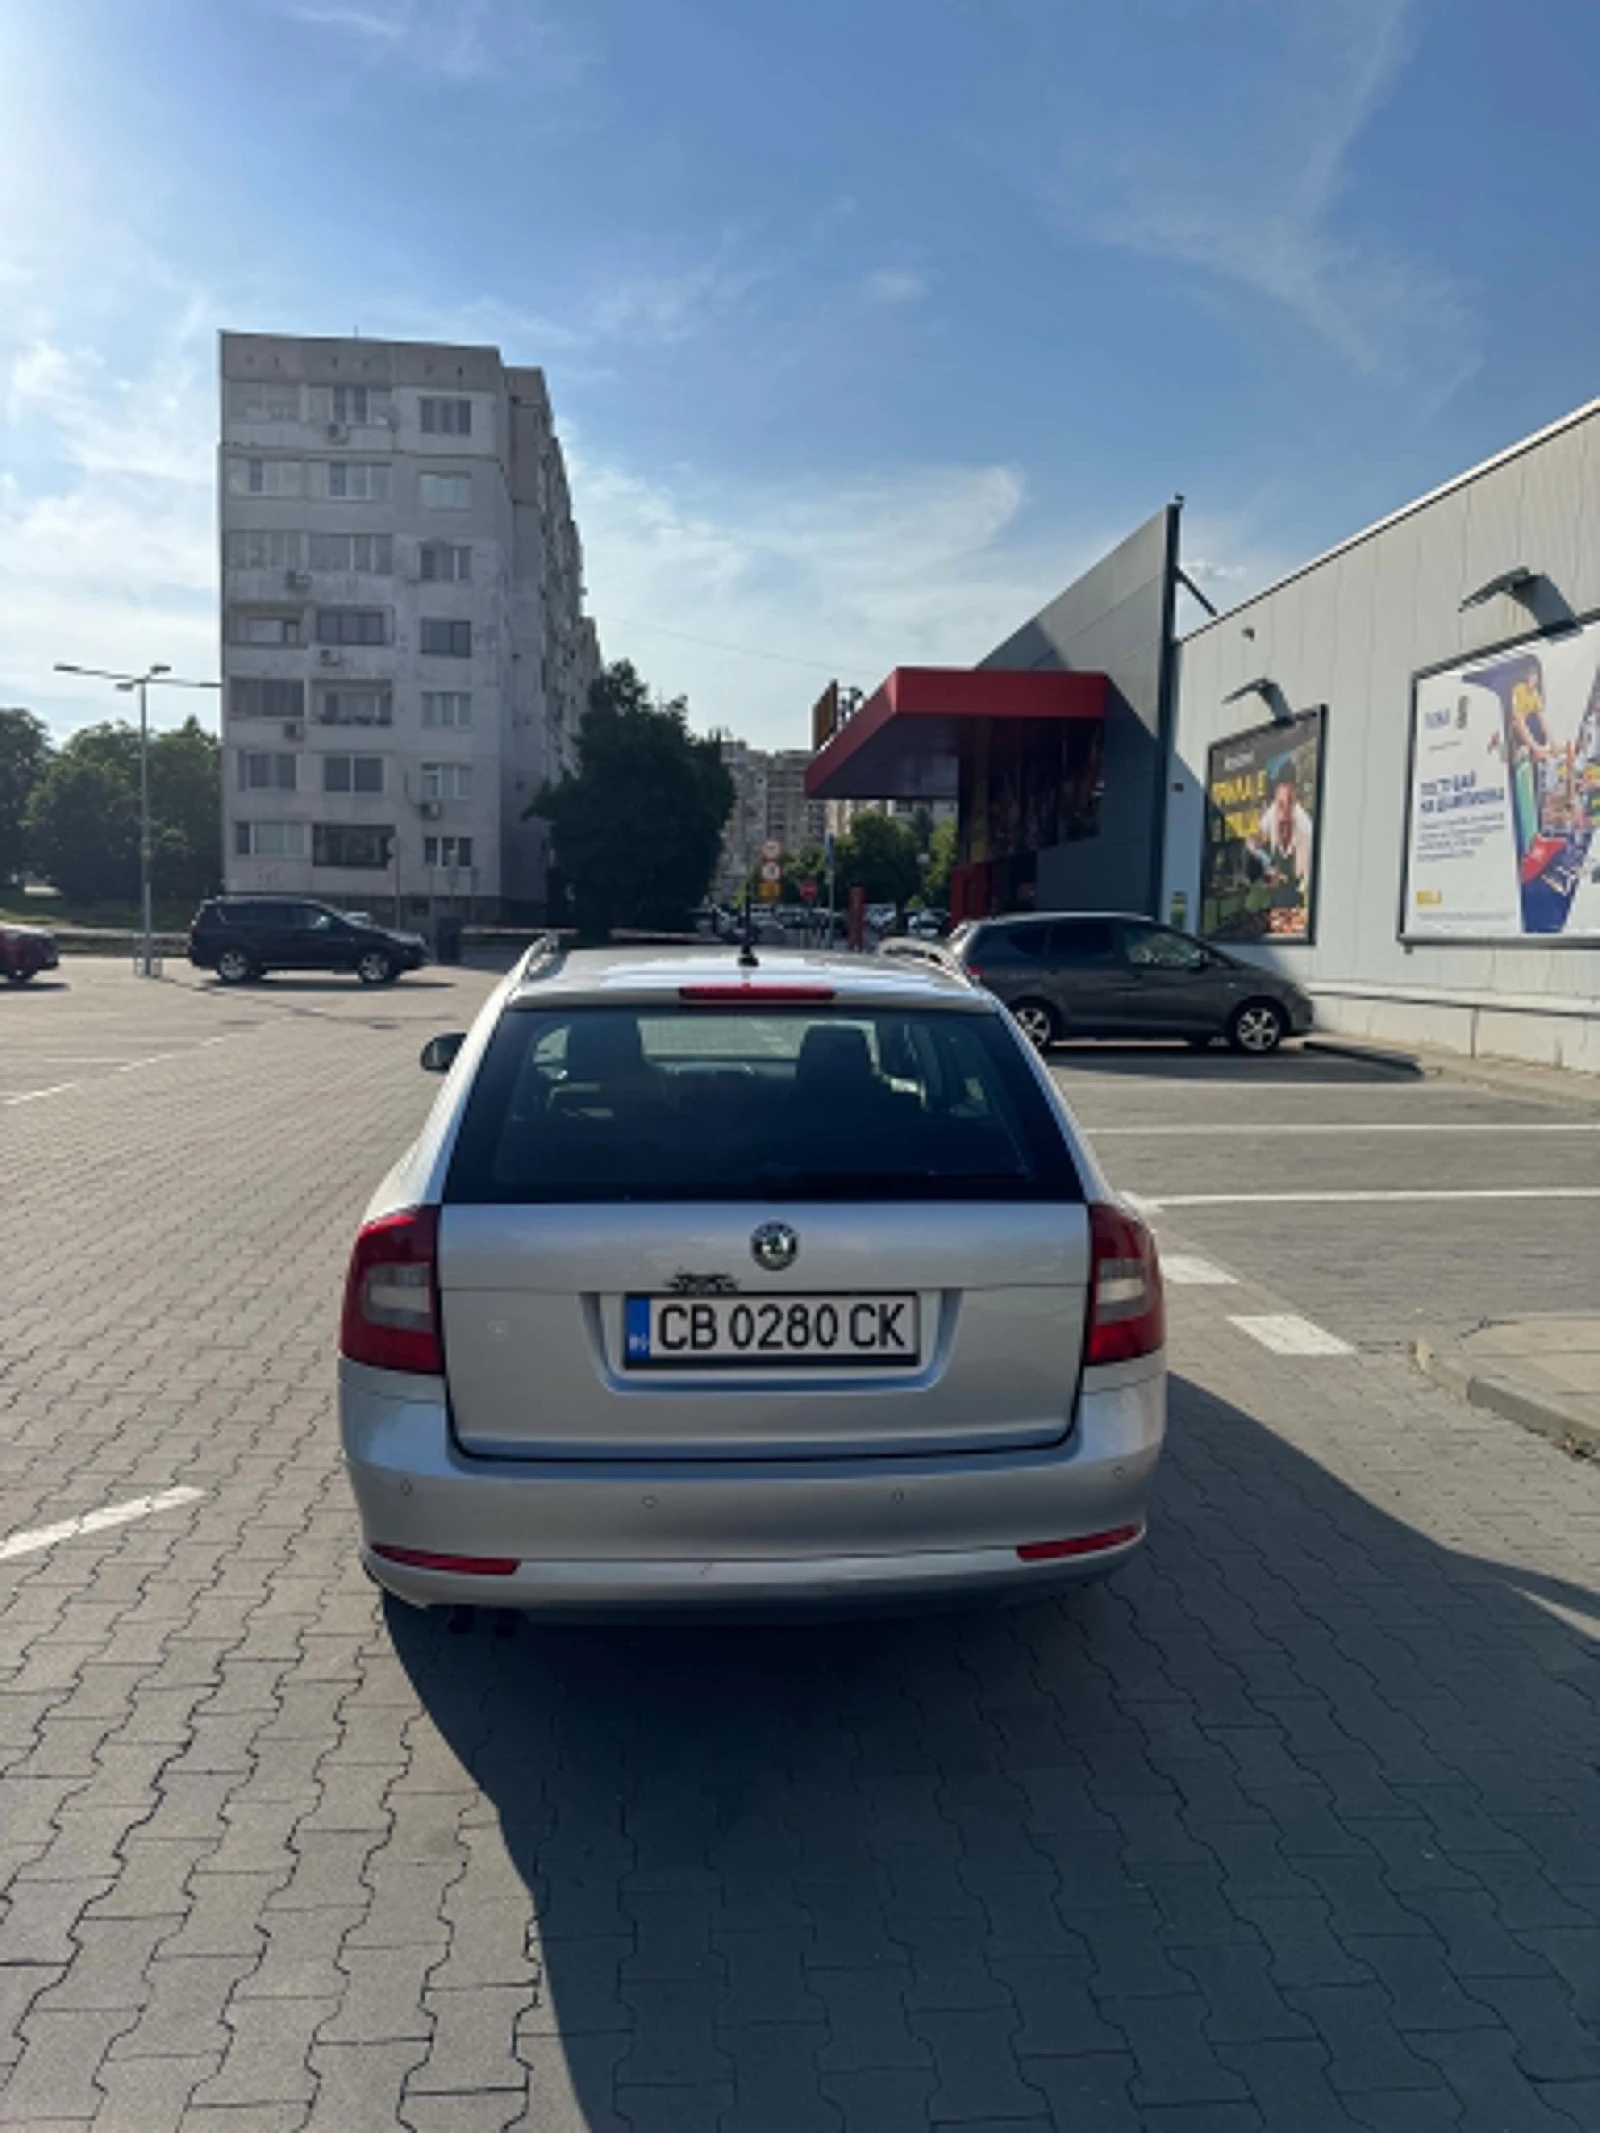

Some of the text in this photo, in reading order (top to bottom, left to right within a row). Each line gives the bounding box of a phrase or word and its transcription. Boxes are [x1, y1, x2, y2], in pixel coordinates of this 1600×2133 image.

[658, 1303, 905, 1349] CB 0280 CK
